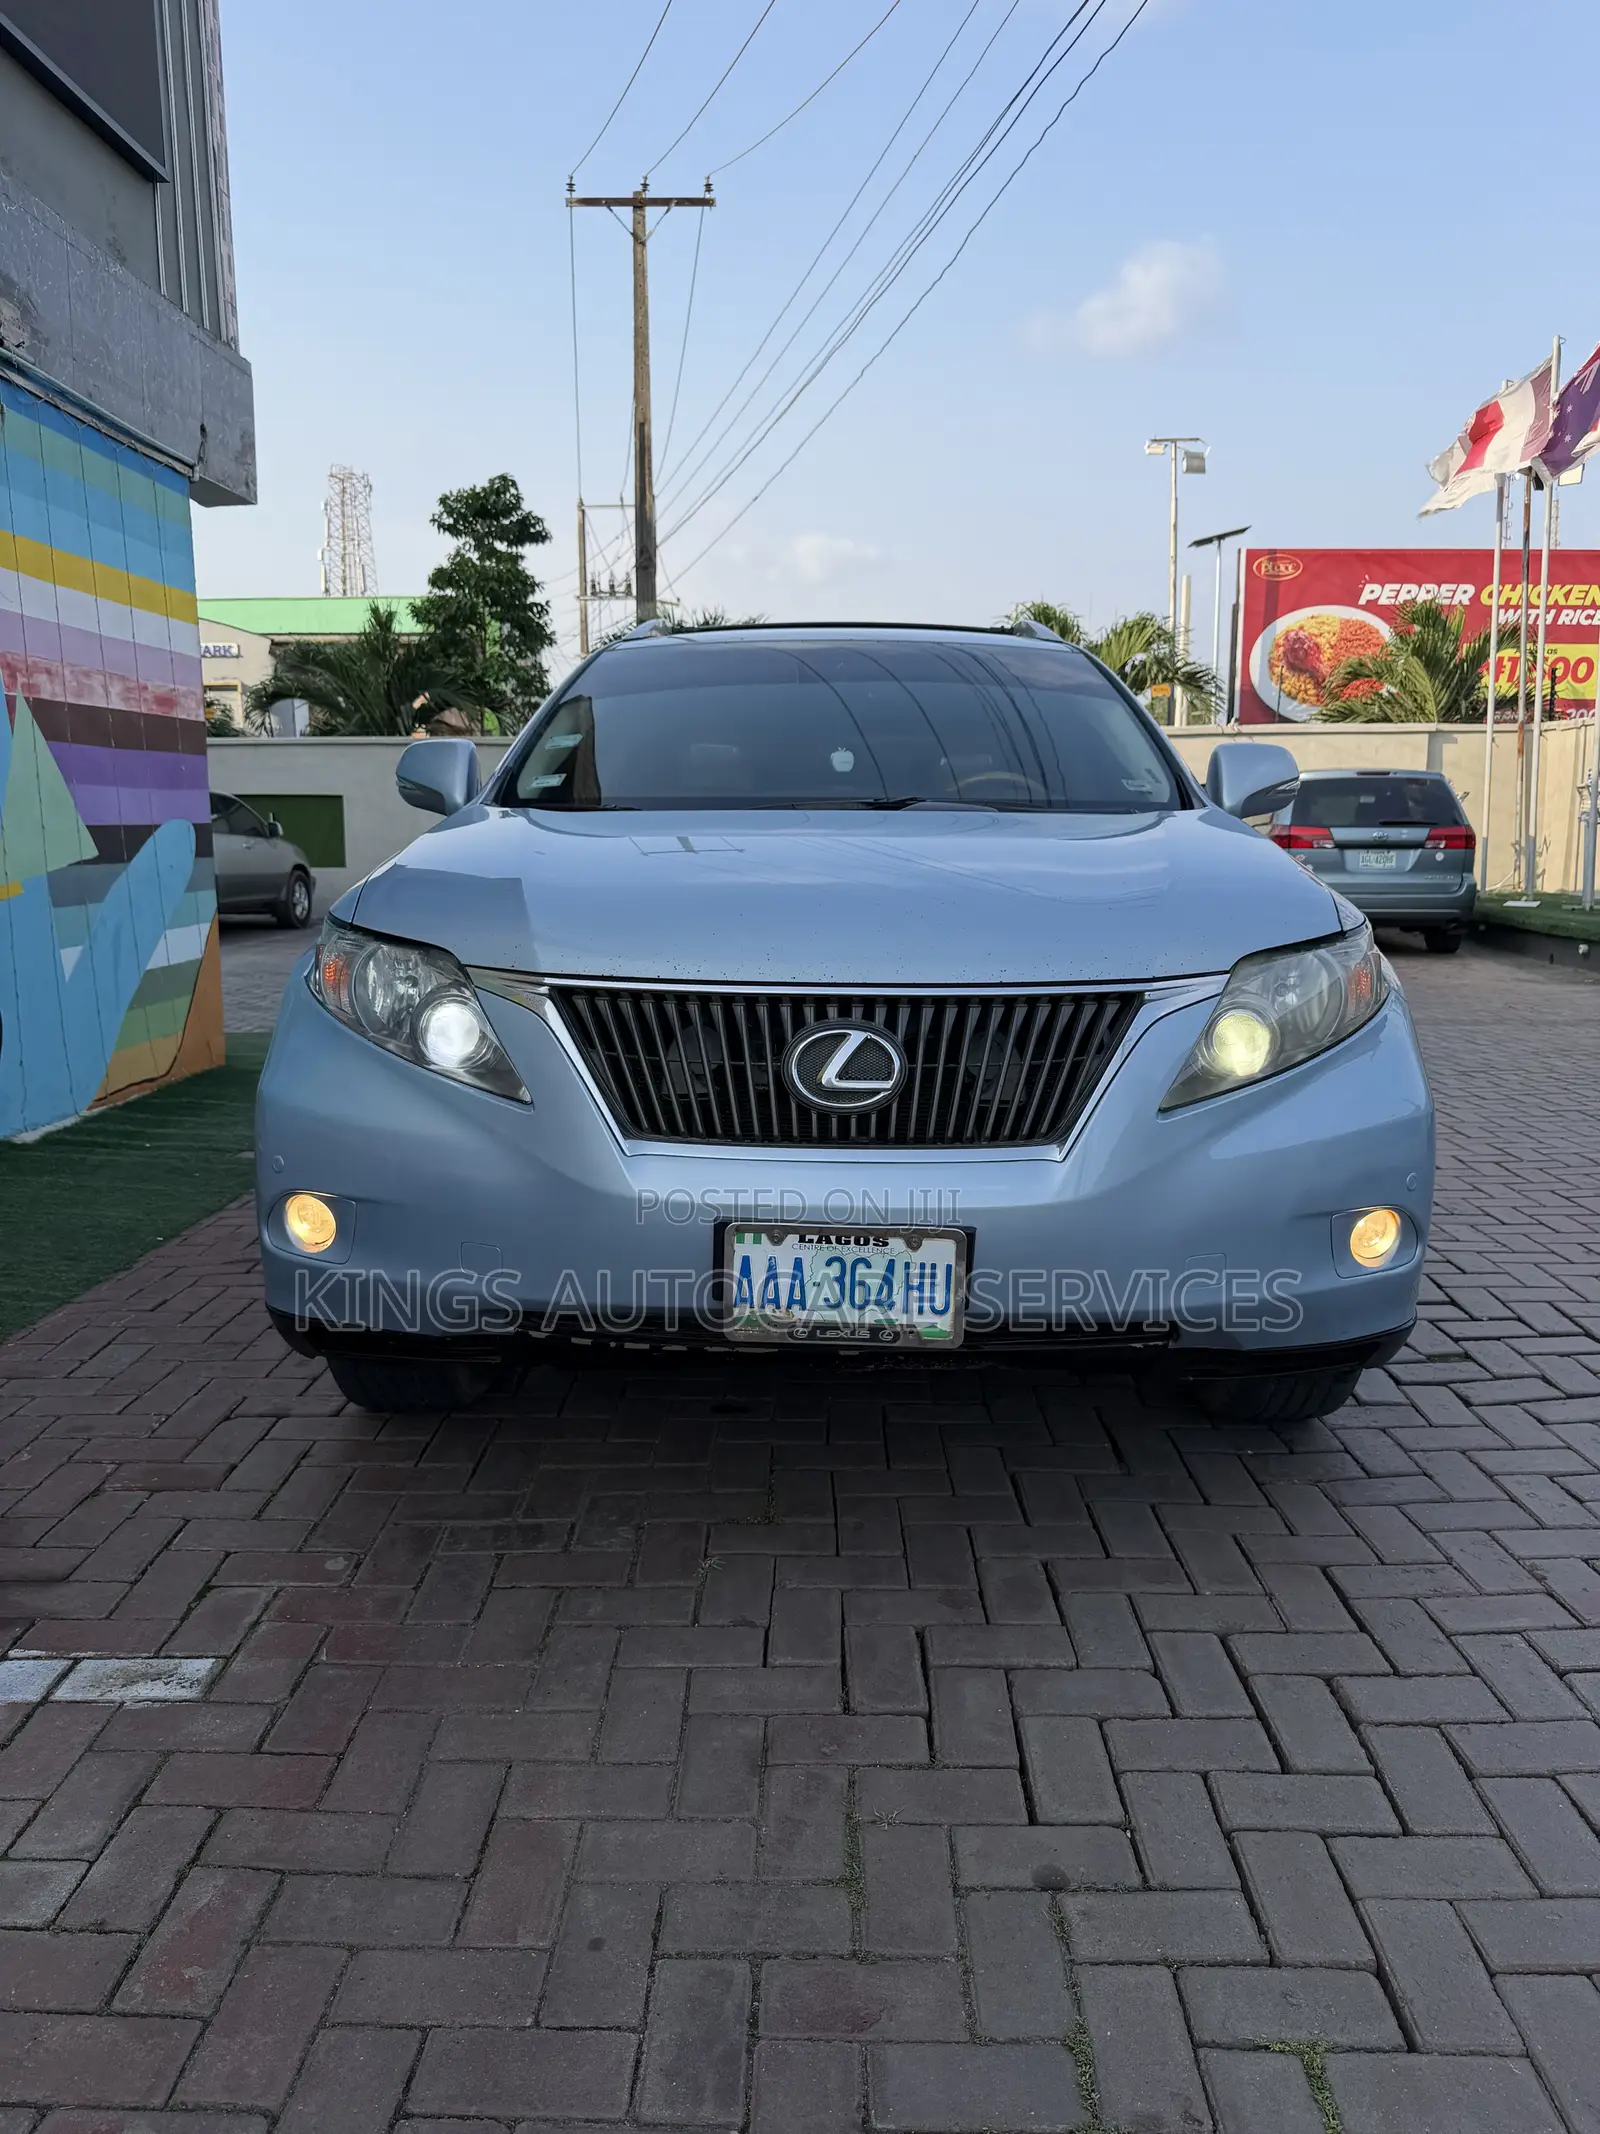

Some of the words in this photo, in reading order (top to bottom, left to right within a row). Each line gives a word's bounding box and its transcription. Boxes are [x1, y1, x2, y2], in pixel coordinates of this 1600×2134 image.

[1358, 584, 1475, 605] PEPPER
[1498, 609, 1556, 625] WTH
[201, 645, 236, 657] ARK
[798, 1234, 890, 1248] LAGOS
[791, 1243, 826, 1252] CENTRE
[827, 1244, 840, 1252] OF
[841, 1245, 895, 1255] EXCELLENCE
[816, 1329, 871, 1339] LEXUS
